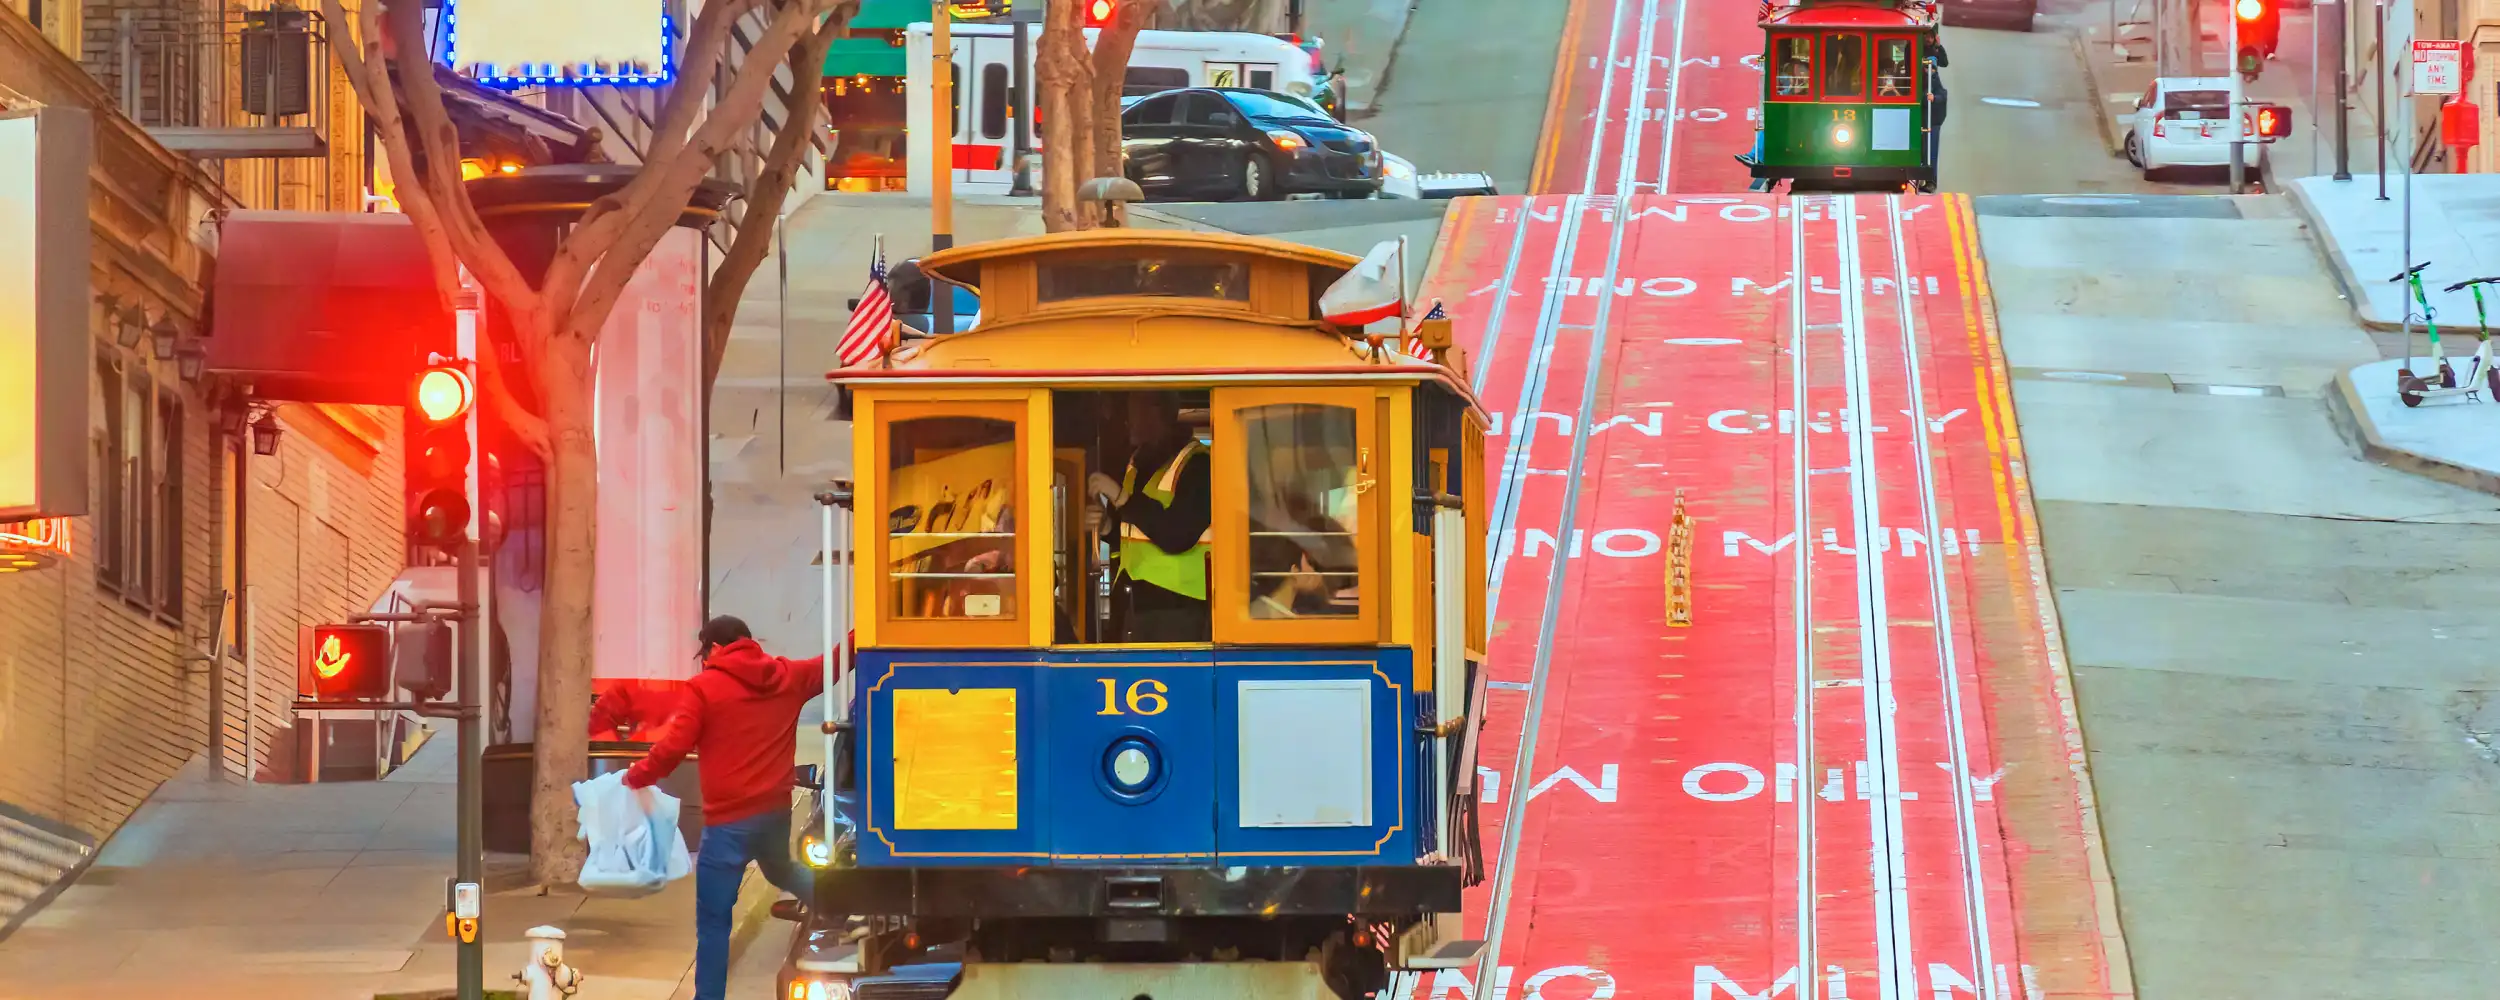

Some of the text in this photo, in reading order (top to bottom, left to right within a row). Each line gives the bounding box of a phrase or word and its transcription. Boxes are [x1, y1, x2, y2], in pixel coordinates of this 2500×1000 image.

[2428, 64, 2445, 73] ANY
[2427, 75, 2447, 85] TIME
[1722, 527, 1981, 557] MUNI
[1096, 678, 1168, 716] 16
